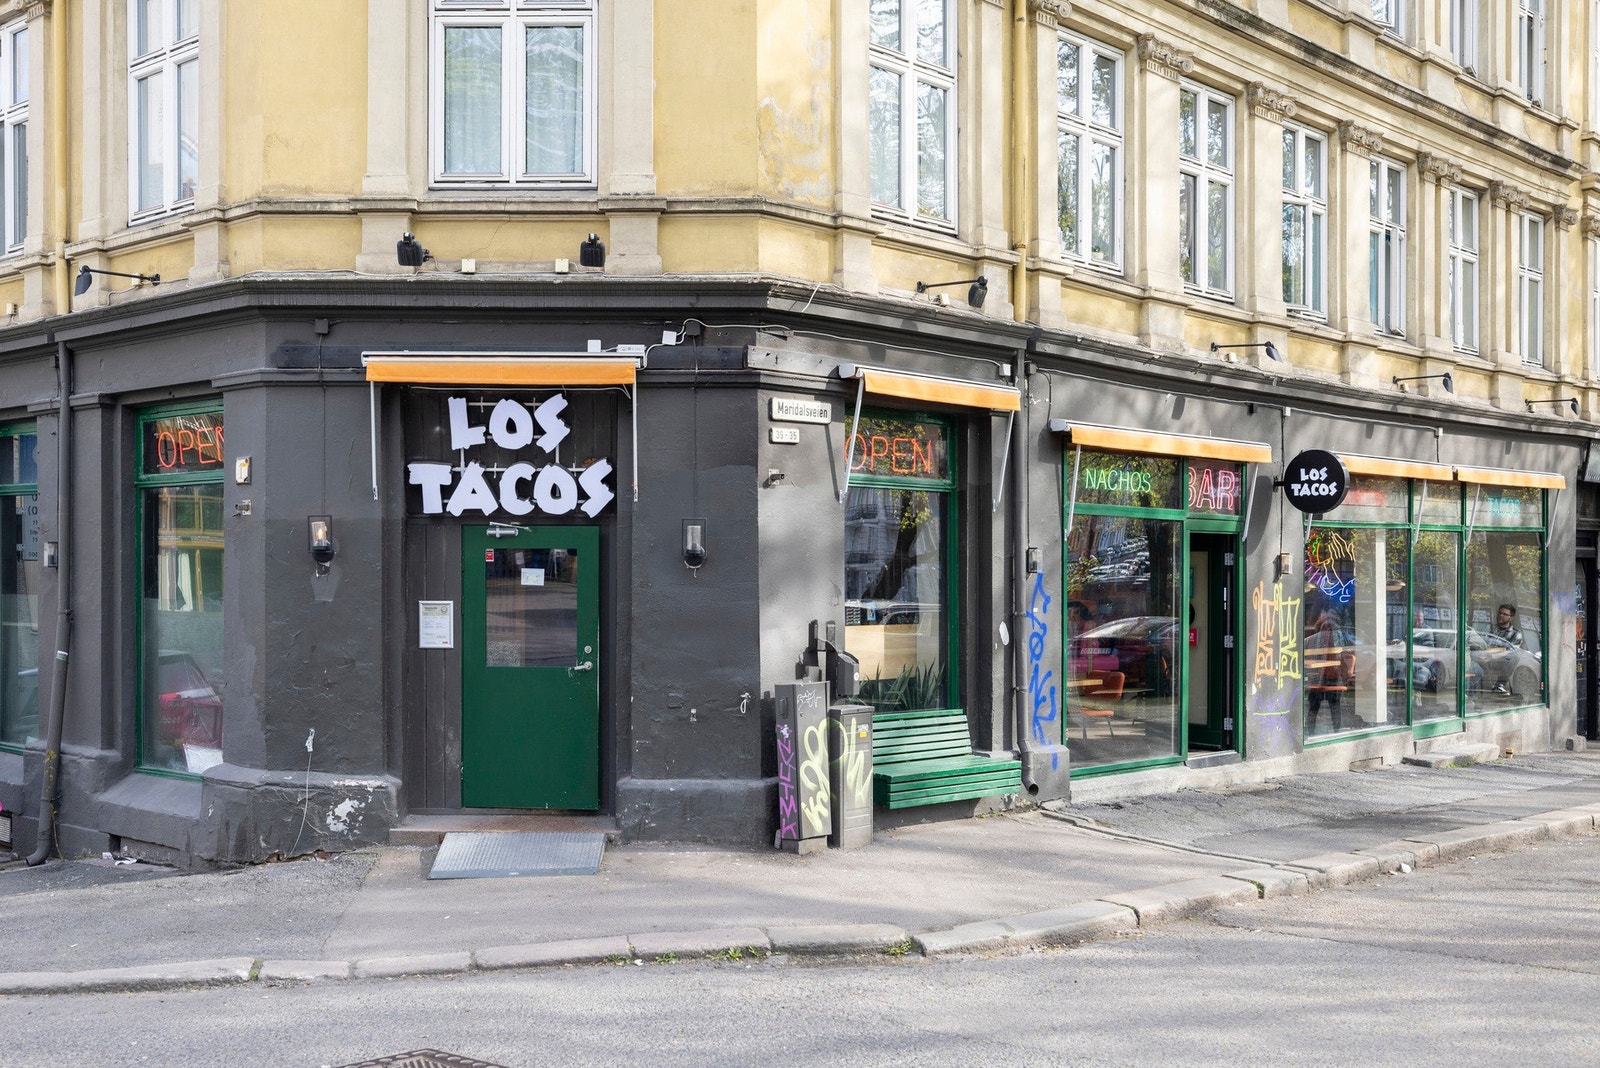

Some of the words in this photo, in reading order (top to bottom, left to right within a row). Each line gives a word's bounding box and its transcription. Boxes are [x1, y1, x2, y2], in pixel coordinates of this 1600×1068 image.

[777, 401, 828, 419] Maridalsveien
[448, 393, 571, 454] LOS
[844, 433, 932, 474] OPEN
[1085, 468, 1151, 493] NACHOS
[1300, 466, 1328, 482] LOS
[407, 458, 615, 518] TACOS
[1291, 482, 1338, 497] TACOS
[1487, 496, 1521, 516] TACOS
